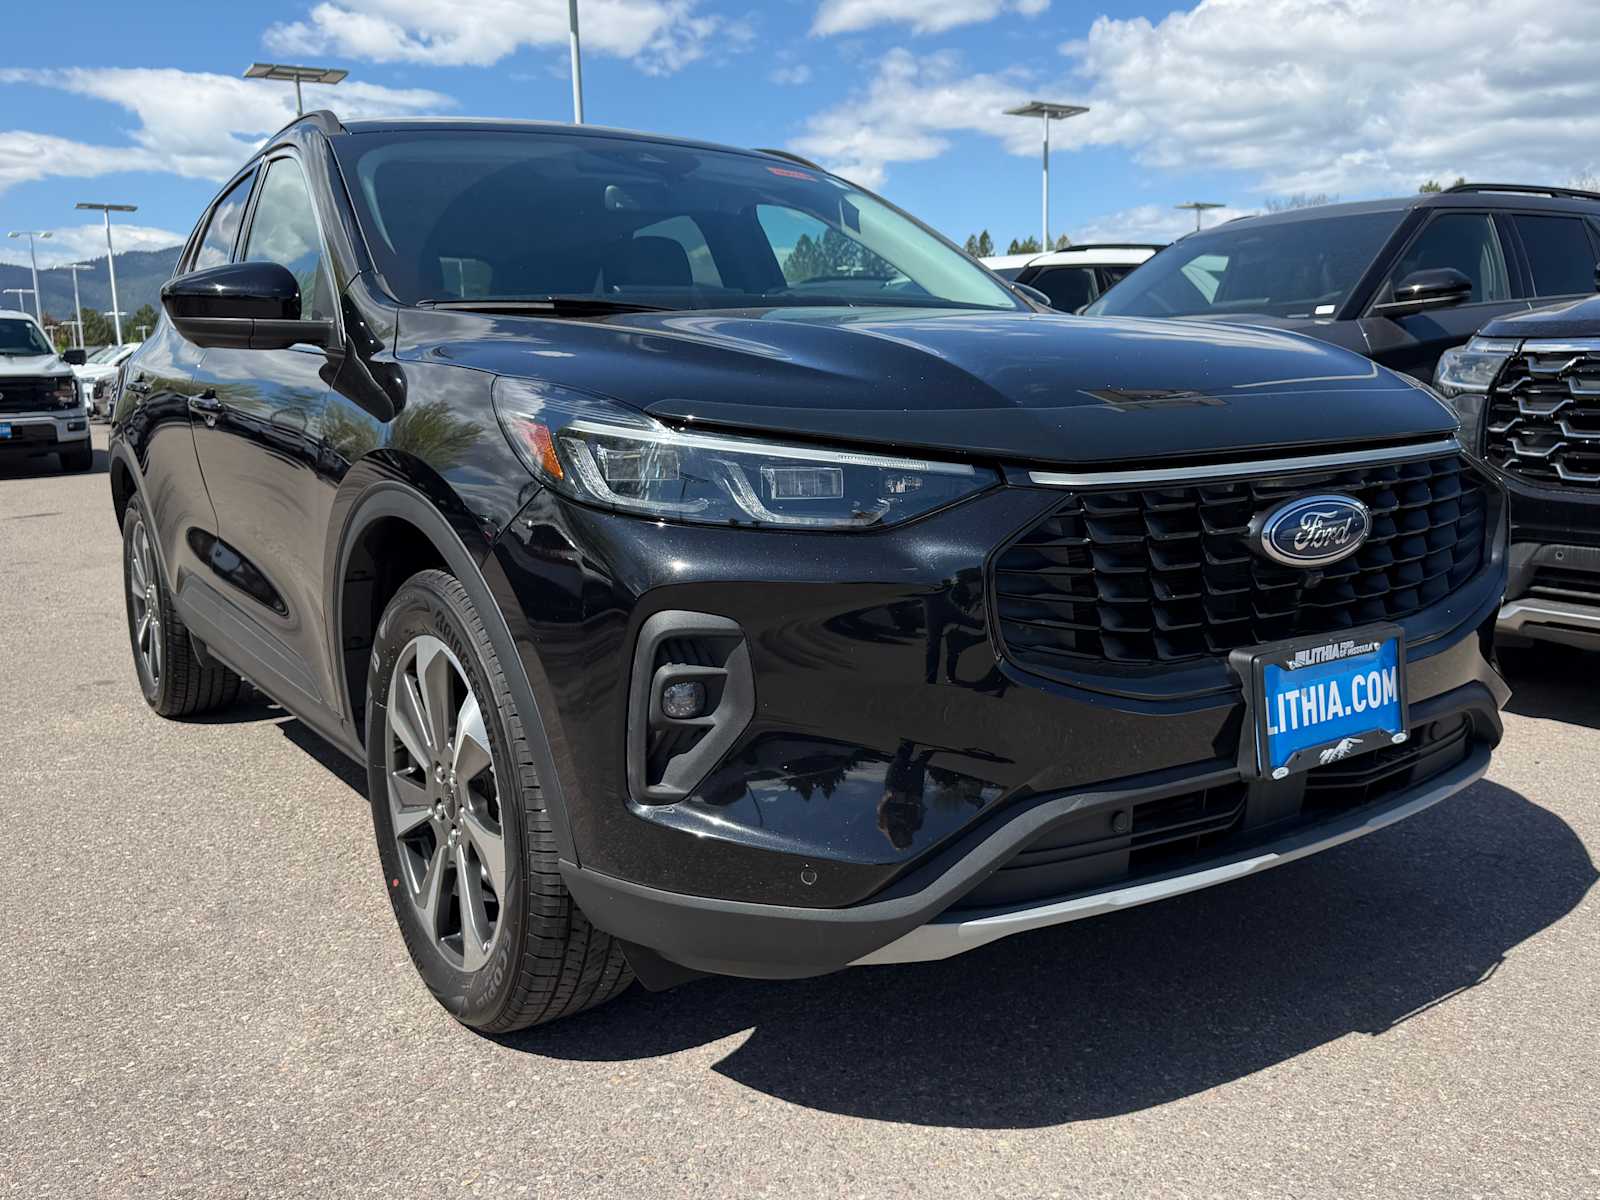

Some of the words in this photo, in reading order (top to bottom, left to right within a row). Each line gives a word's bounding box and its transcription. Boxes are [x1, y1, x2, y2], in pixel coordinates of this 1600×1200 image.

[1293, 511, 1352, 551] Ford
[1305, 643, 1340, 665] LITHIA
[1264, 666, 1398, 736] LITHIA.COM
